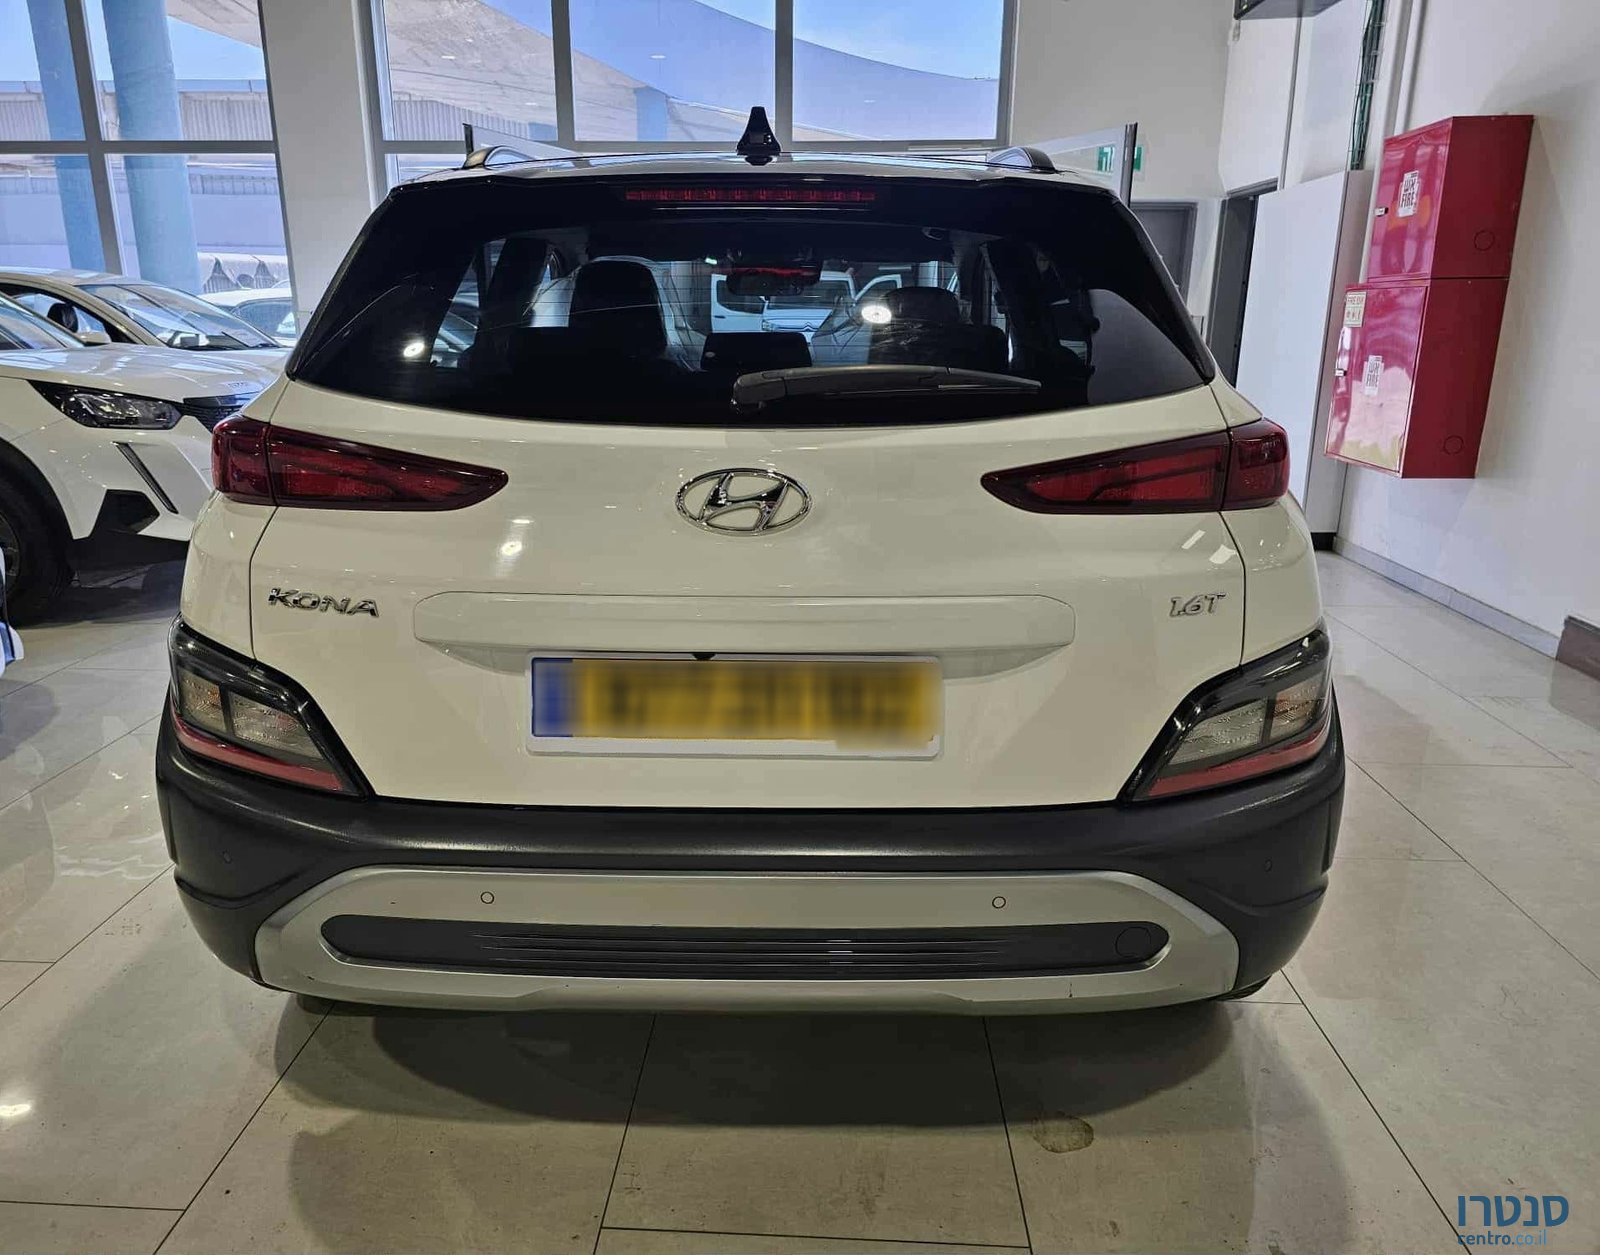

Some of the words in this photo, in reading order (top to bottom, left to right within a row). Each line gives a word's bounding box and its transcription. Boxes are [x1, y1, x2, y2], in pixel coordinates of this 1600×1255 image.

[1400, 191, 1415, 208] FIRE
[268, 588, 379, 618] KONA
[1169, 592, 1227, 617] 1.6T
